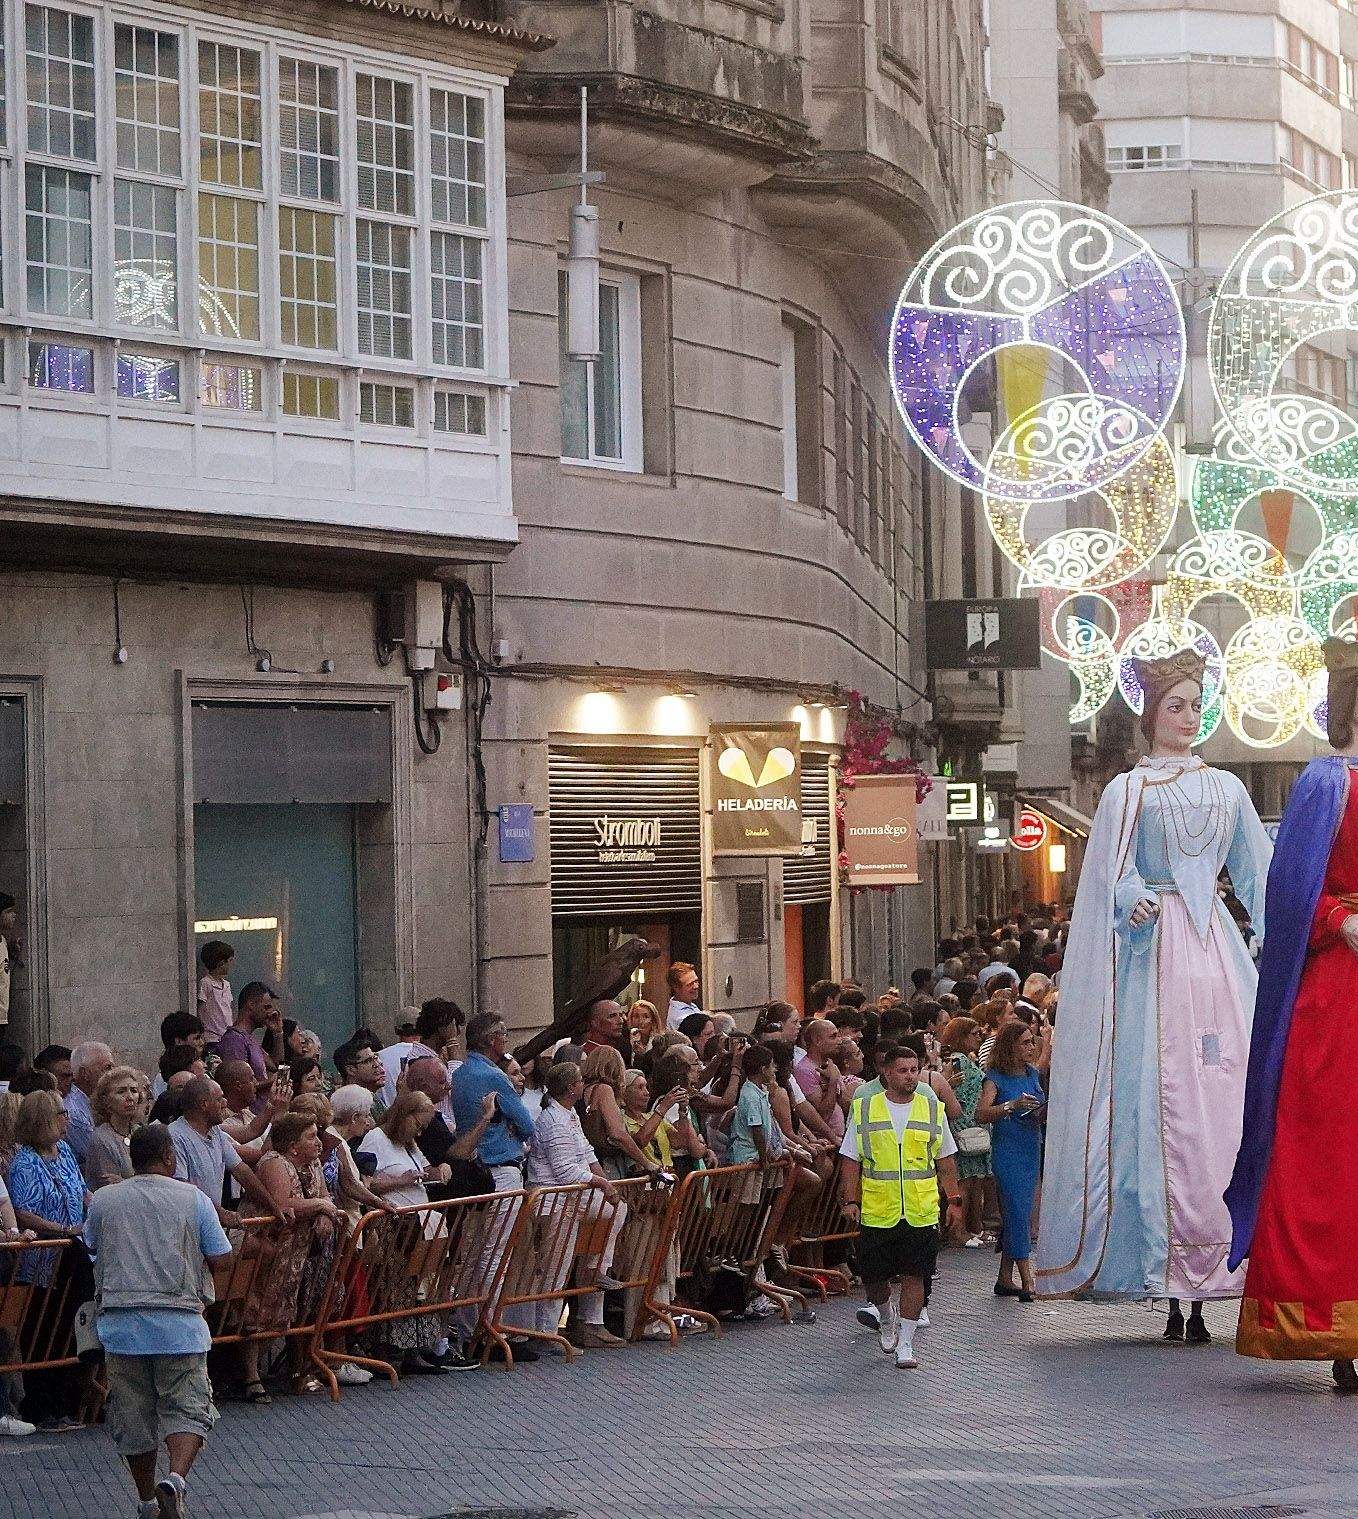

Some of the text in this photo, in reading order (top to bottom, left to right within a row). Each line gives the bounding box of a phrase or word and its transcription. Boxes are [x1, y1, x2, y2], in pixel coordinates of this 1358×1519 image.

[966, 605, 999, 613] EUROPA
[967, 655, 1000, 663] NOTARIO
[717, 795, 798, 812] HELADERÍA
[593, 815, 661, 847] Stromboli
[849, 824, 907, 837] nonna&go
